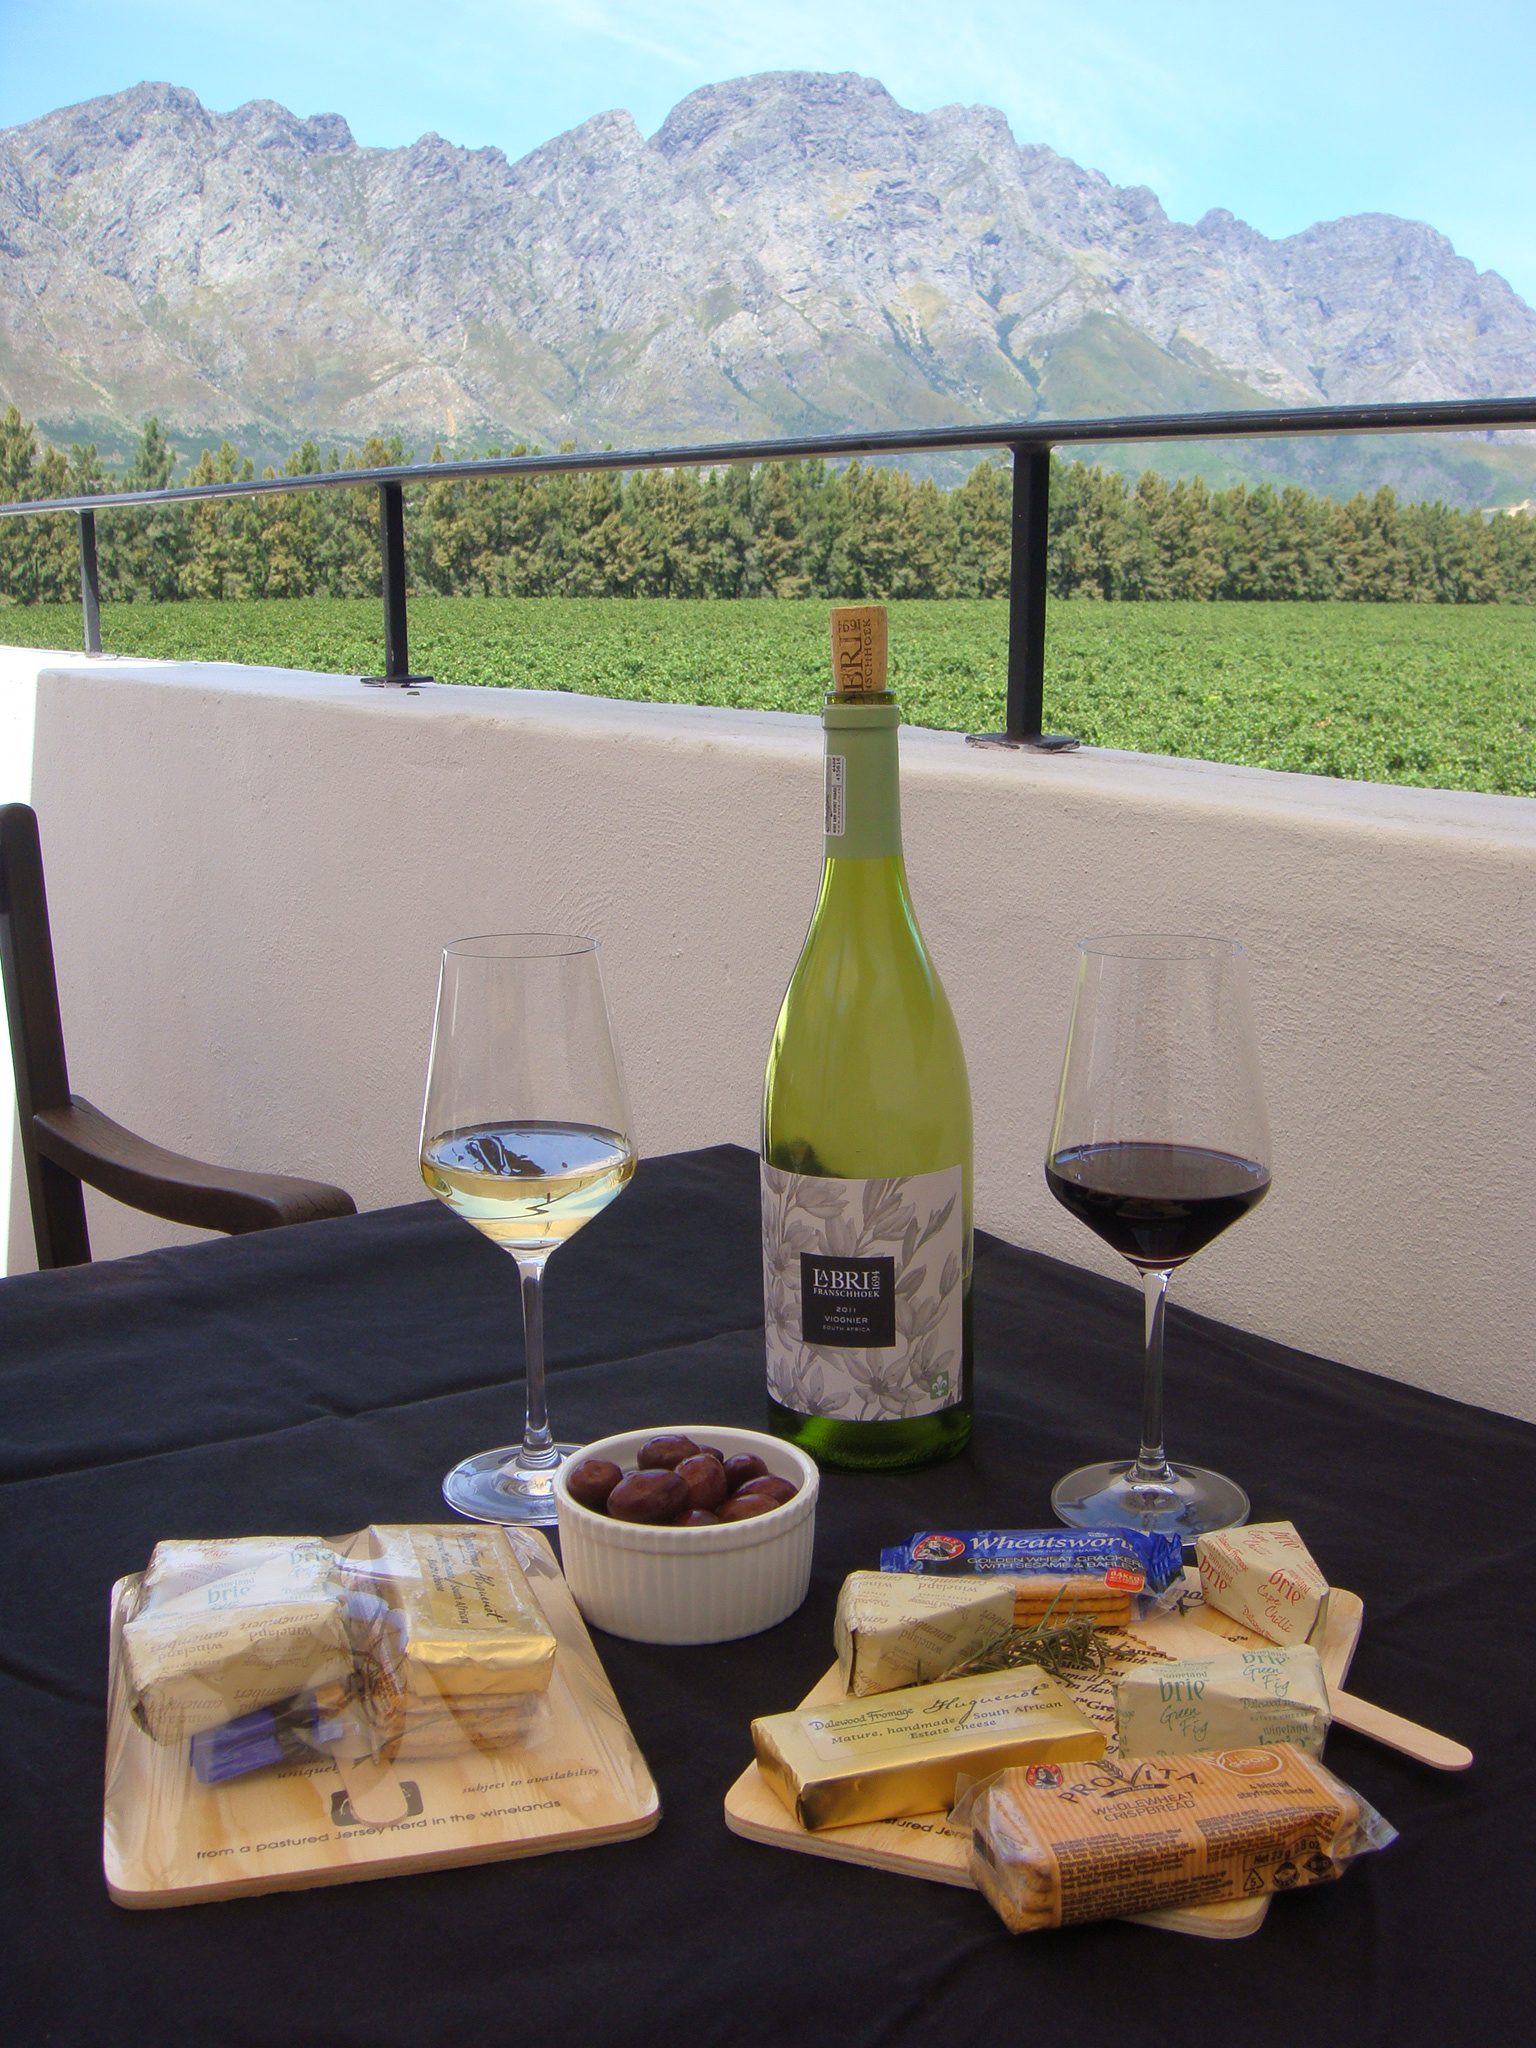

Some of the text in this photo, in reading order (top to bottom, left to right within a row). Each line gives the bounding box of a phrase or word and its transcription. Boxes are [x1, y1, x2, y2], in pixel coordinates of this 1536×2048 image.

[871, 1270, 880, 1290] 1694
[813, 1287, 880, 1298] FRANSCHHOEK
[824, 1315, 868, 1324] VIOGNIER
[967, 1556, 1024, 1564] GOLDEN
[1026, 1555, 1073, 1563] WHEAT
[979, 1562, 1013, 1570] WITH
[1017, 1561, 1067, 1569] SESAME
[1087, 1561, 1138, 1572] BARLEY
[1199, 1556, 1229, 1593] brie
[918, 1583, 978, 1593] wineland
[1268, 1568, 1303, 1606] brie
[249, 1626, 313, 1643] wineland
[157, 1642, 224, 1664] wineland
[1242, 1664, 1283, 1682] Green
[1158, 1676, 1206, 1702] brie
[1262, 1674, 1291, 1698] Fig
[809, 1708, 914, 1731] Dalewood Fromage
[832, 1699, 1063, 1745] Mature, handmade South African
[910, 1718, 997, 1740] Estate cheese
[1159, 1704, 1201, 1732] Green
[1263, 1722, 1309, 1735] wineland
[1179, 1720, 1210, 1742] Fig
[462, 1767, 600, 1795] subject to availability
[1092, 1791, 1197, 1816] WHOLEWHEAT
[1104, 1800, 1197, 1823] CRISPBREAD
[196, 1847, 235, 1859] from
[239, 1845, 251, 1853] a
[256, 1833, 329, 1852] pastured
[335, 1825, 386, 1842] Jersey
[432, 1815, 447, 1825] in
[450, 1810, 477, 1823] the
[480, 1799, 562, 1819] winelands
